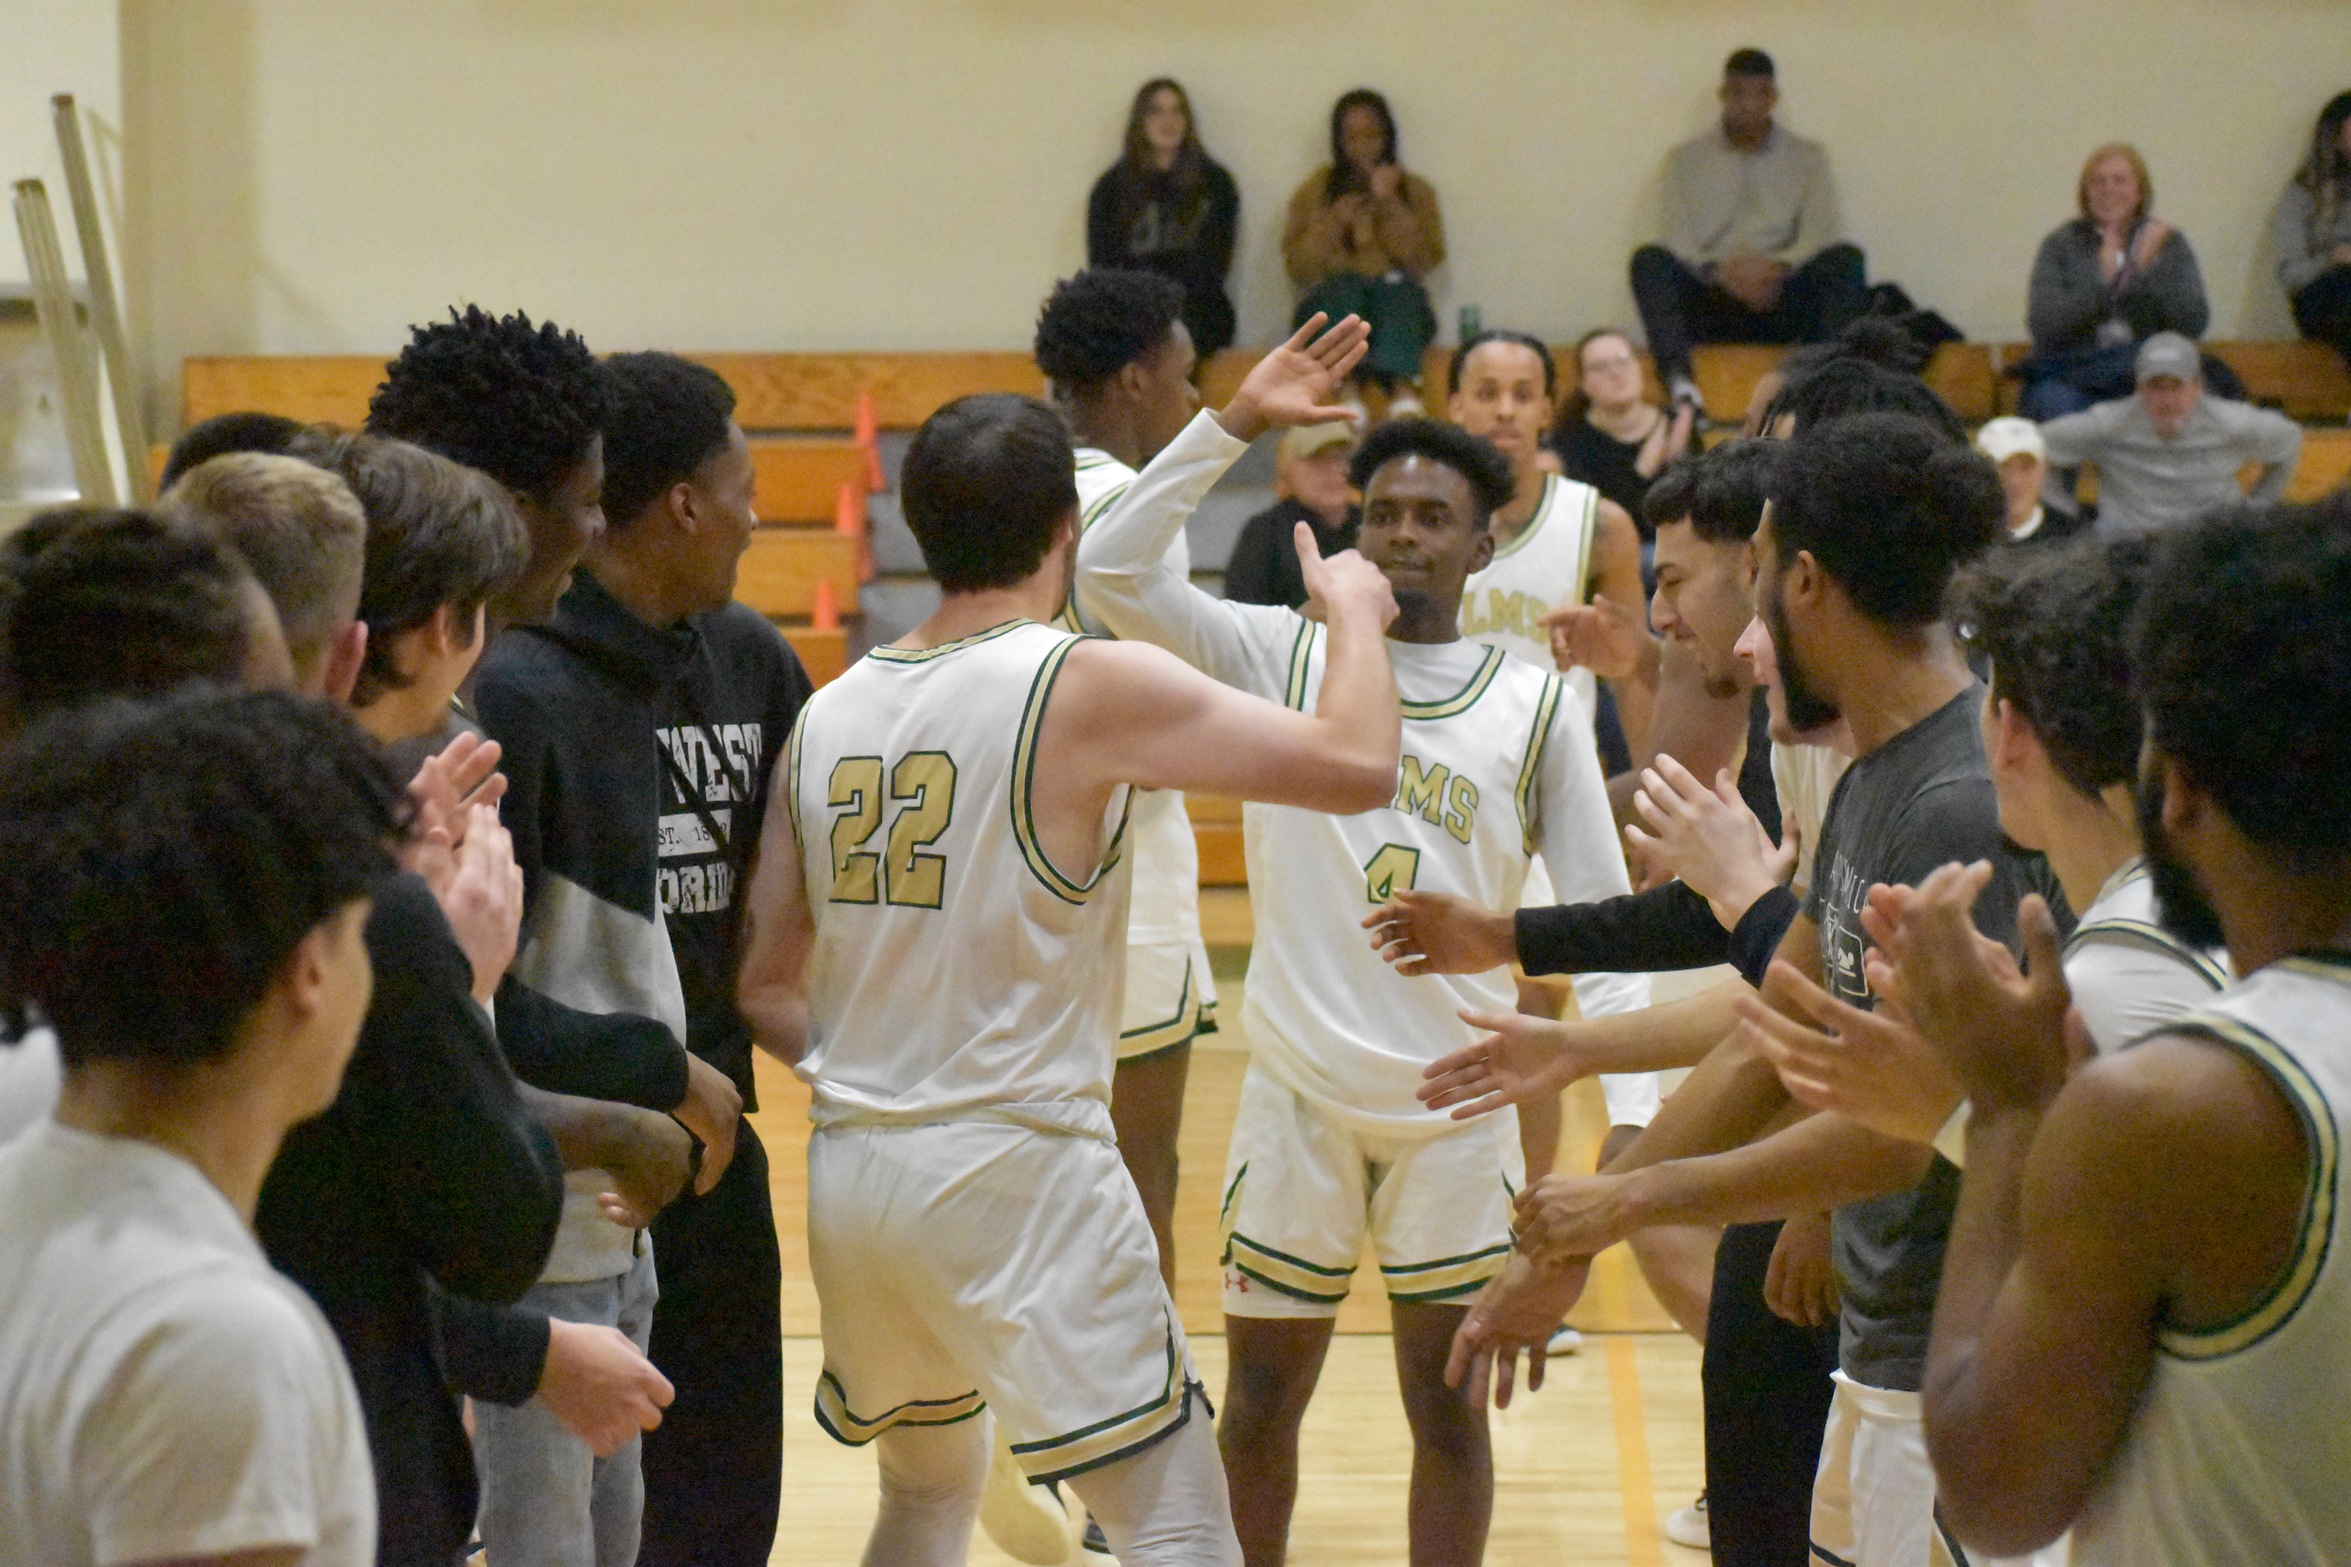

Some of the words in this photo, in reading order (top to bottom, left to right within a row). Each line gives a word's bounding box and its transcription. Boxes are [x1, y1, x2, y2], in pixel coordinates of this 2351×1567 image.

[828, 751, 958, 910] 22
[1385, 754, 1480, 845] MS
[1364, 842, 1421, 904] 4
